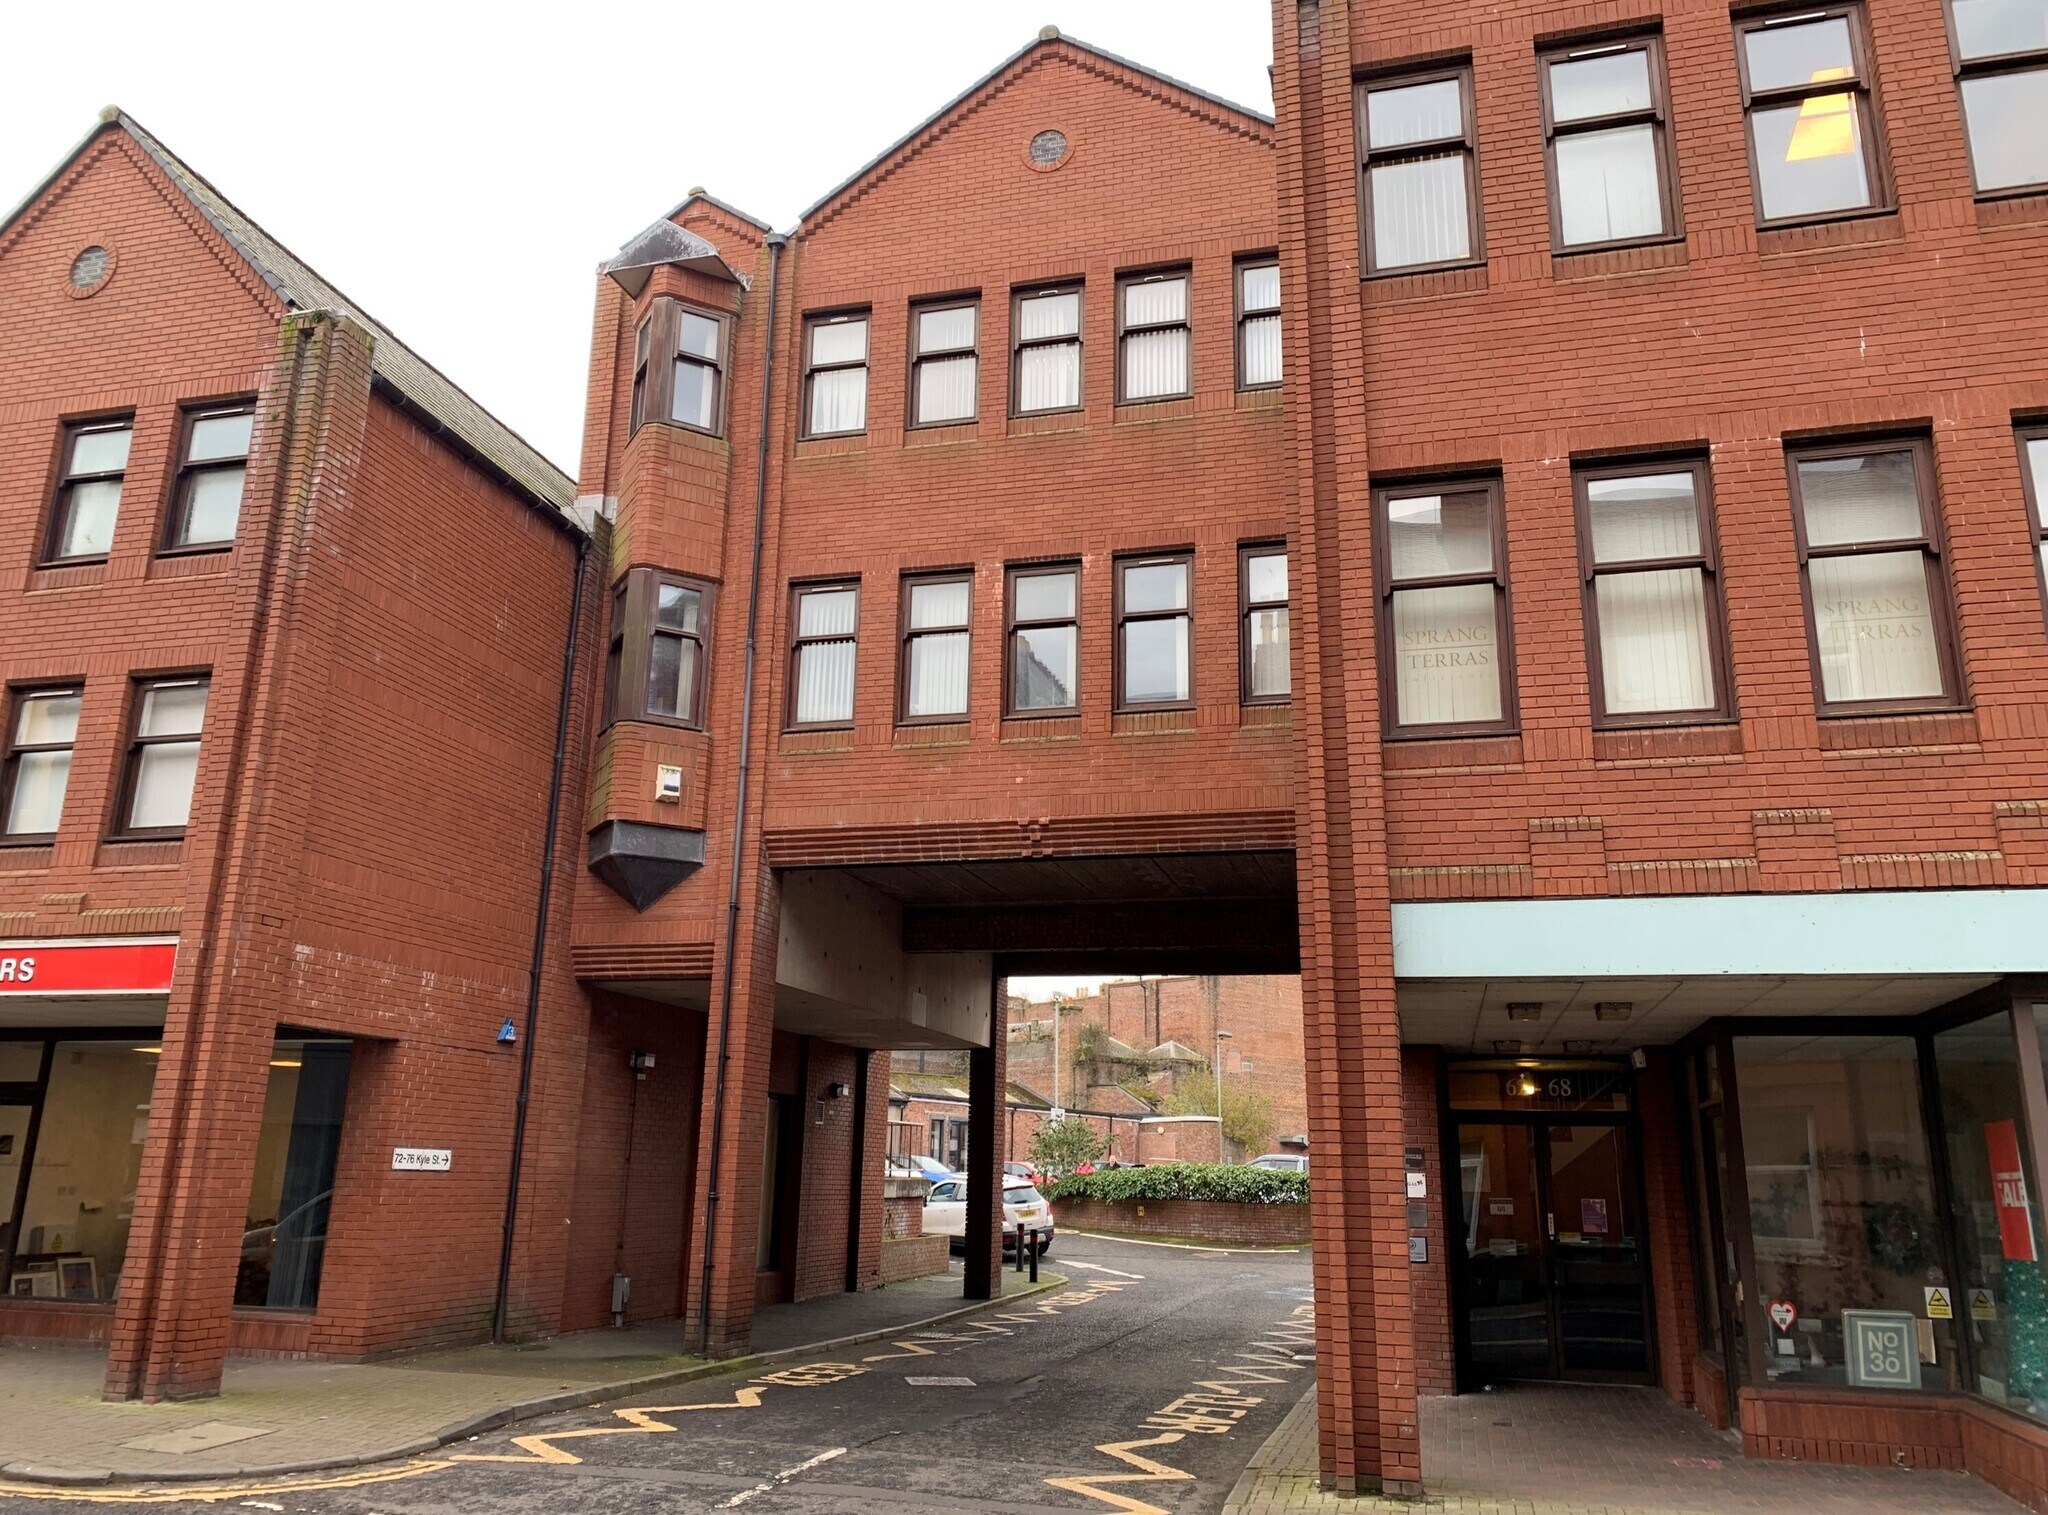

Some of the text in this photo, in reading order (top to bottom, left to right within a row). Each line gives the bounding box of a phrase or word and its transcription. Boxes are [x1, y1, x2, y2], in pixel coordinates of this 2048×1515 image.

[1824, 596, 1920, 617] SPRANG
[1404, 626, 1488, 645] SPRANG
[1831, 622, 1923, 642] TERRAS
[1406, 650, 1489, 669] TERRAS
[1548, 1078, 1572, 1097] 68
[394, 1153, 415, 1164] 72-76
[416, 1154, 430, 1166] Kyle
[1869, 1352, 1900, 1373] 30
[747, 1362, 873, 1387] KEEP
[1137, 1393, 1266, 1434] CLEAR
